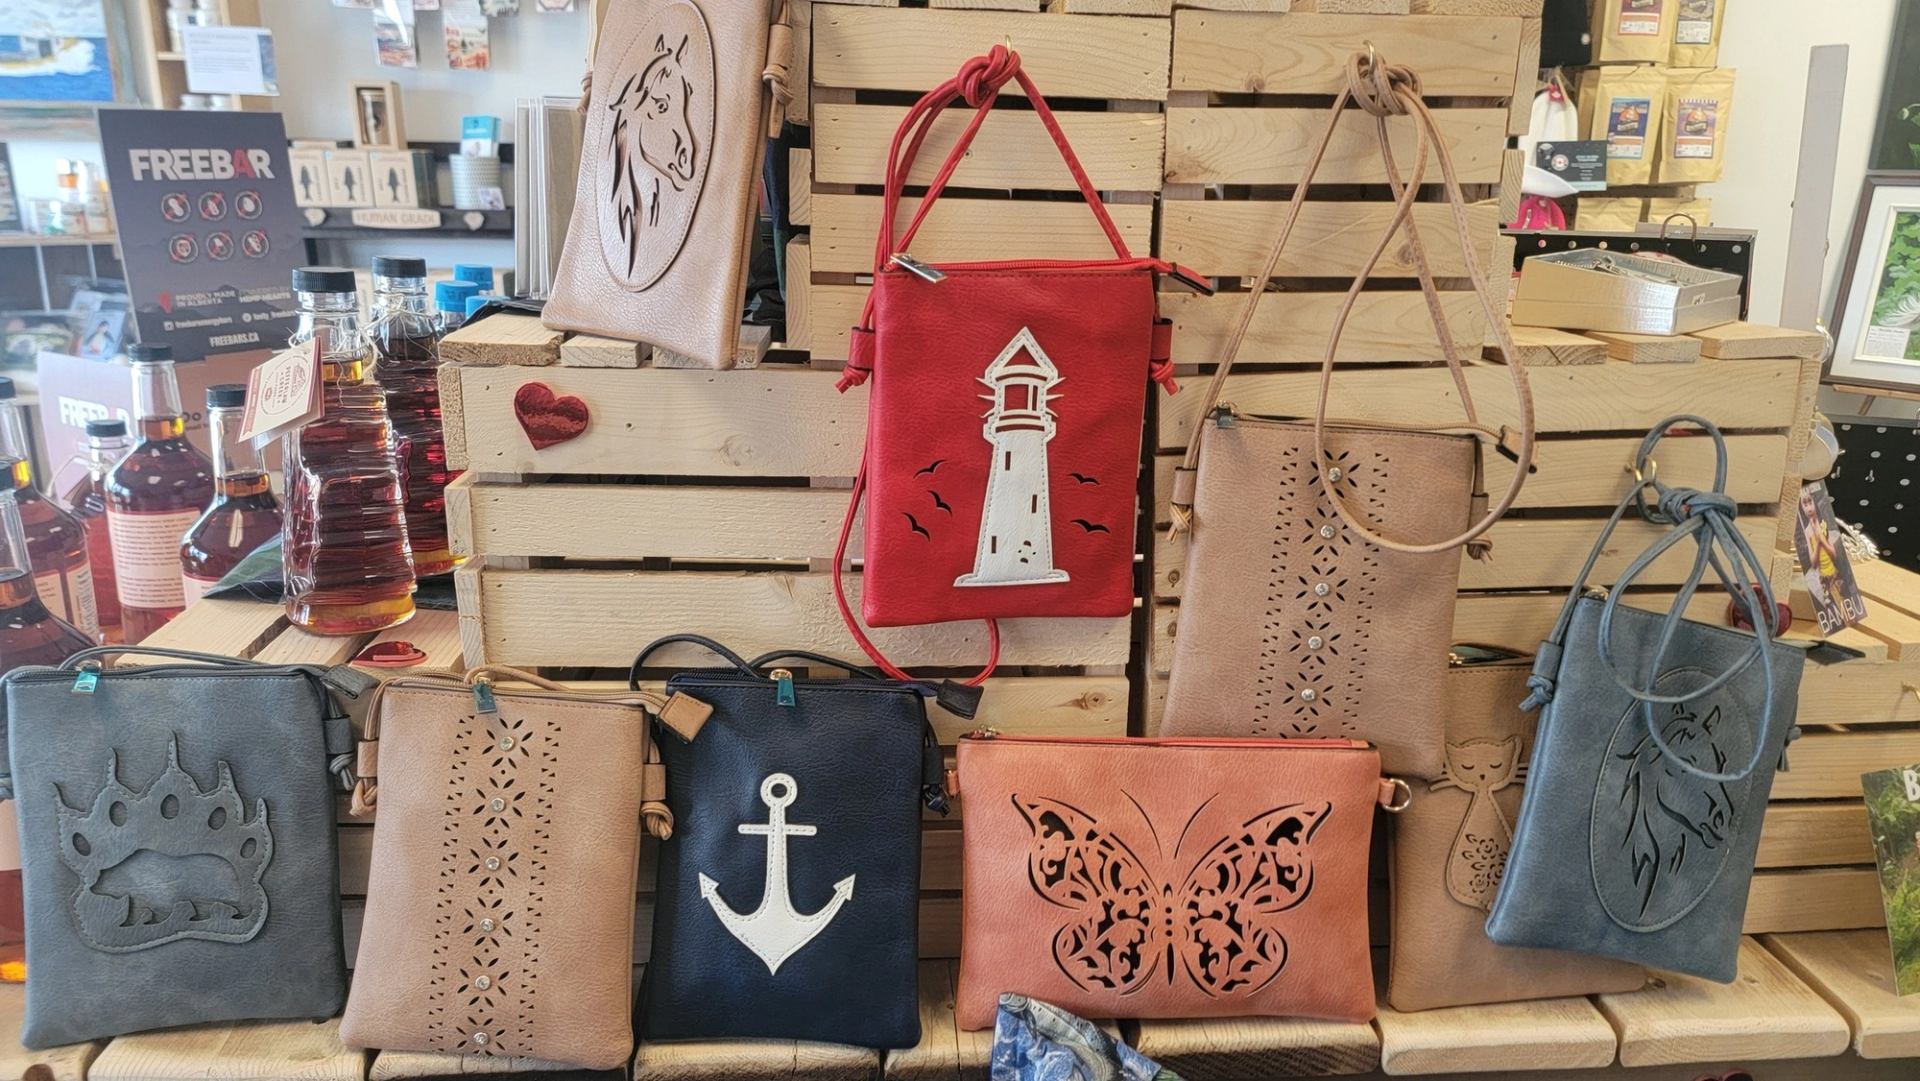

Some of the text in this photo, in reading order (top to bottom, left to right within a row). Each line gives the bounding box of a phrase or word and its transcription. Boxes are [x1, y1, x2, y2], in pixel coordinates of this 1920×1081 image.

[128, 148, 276, 181] FREEBAR
[213, 290, 236, 298] MADE
[209, 332, 260, 347] FREEBARS.CA
[1817, 594, 1864, 634] BAMBU
